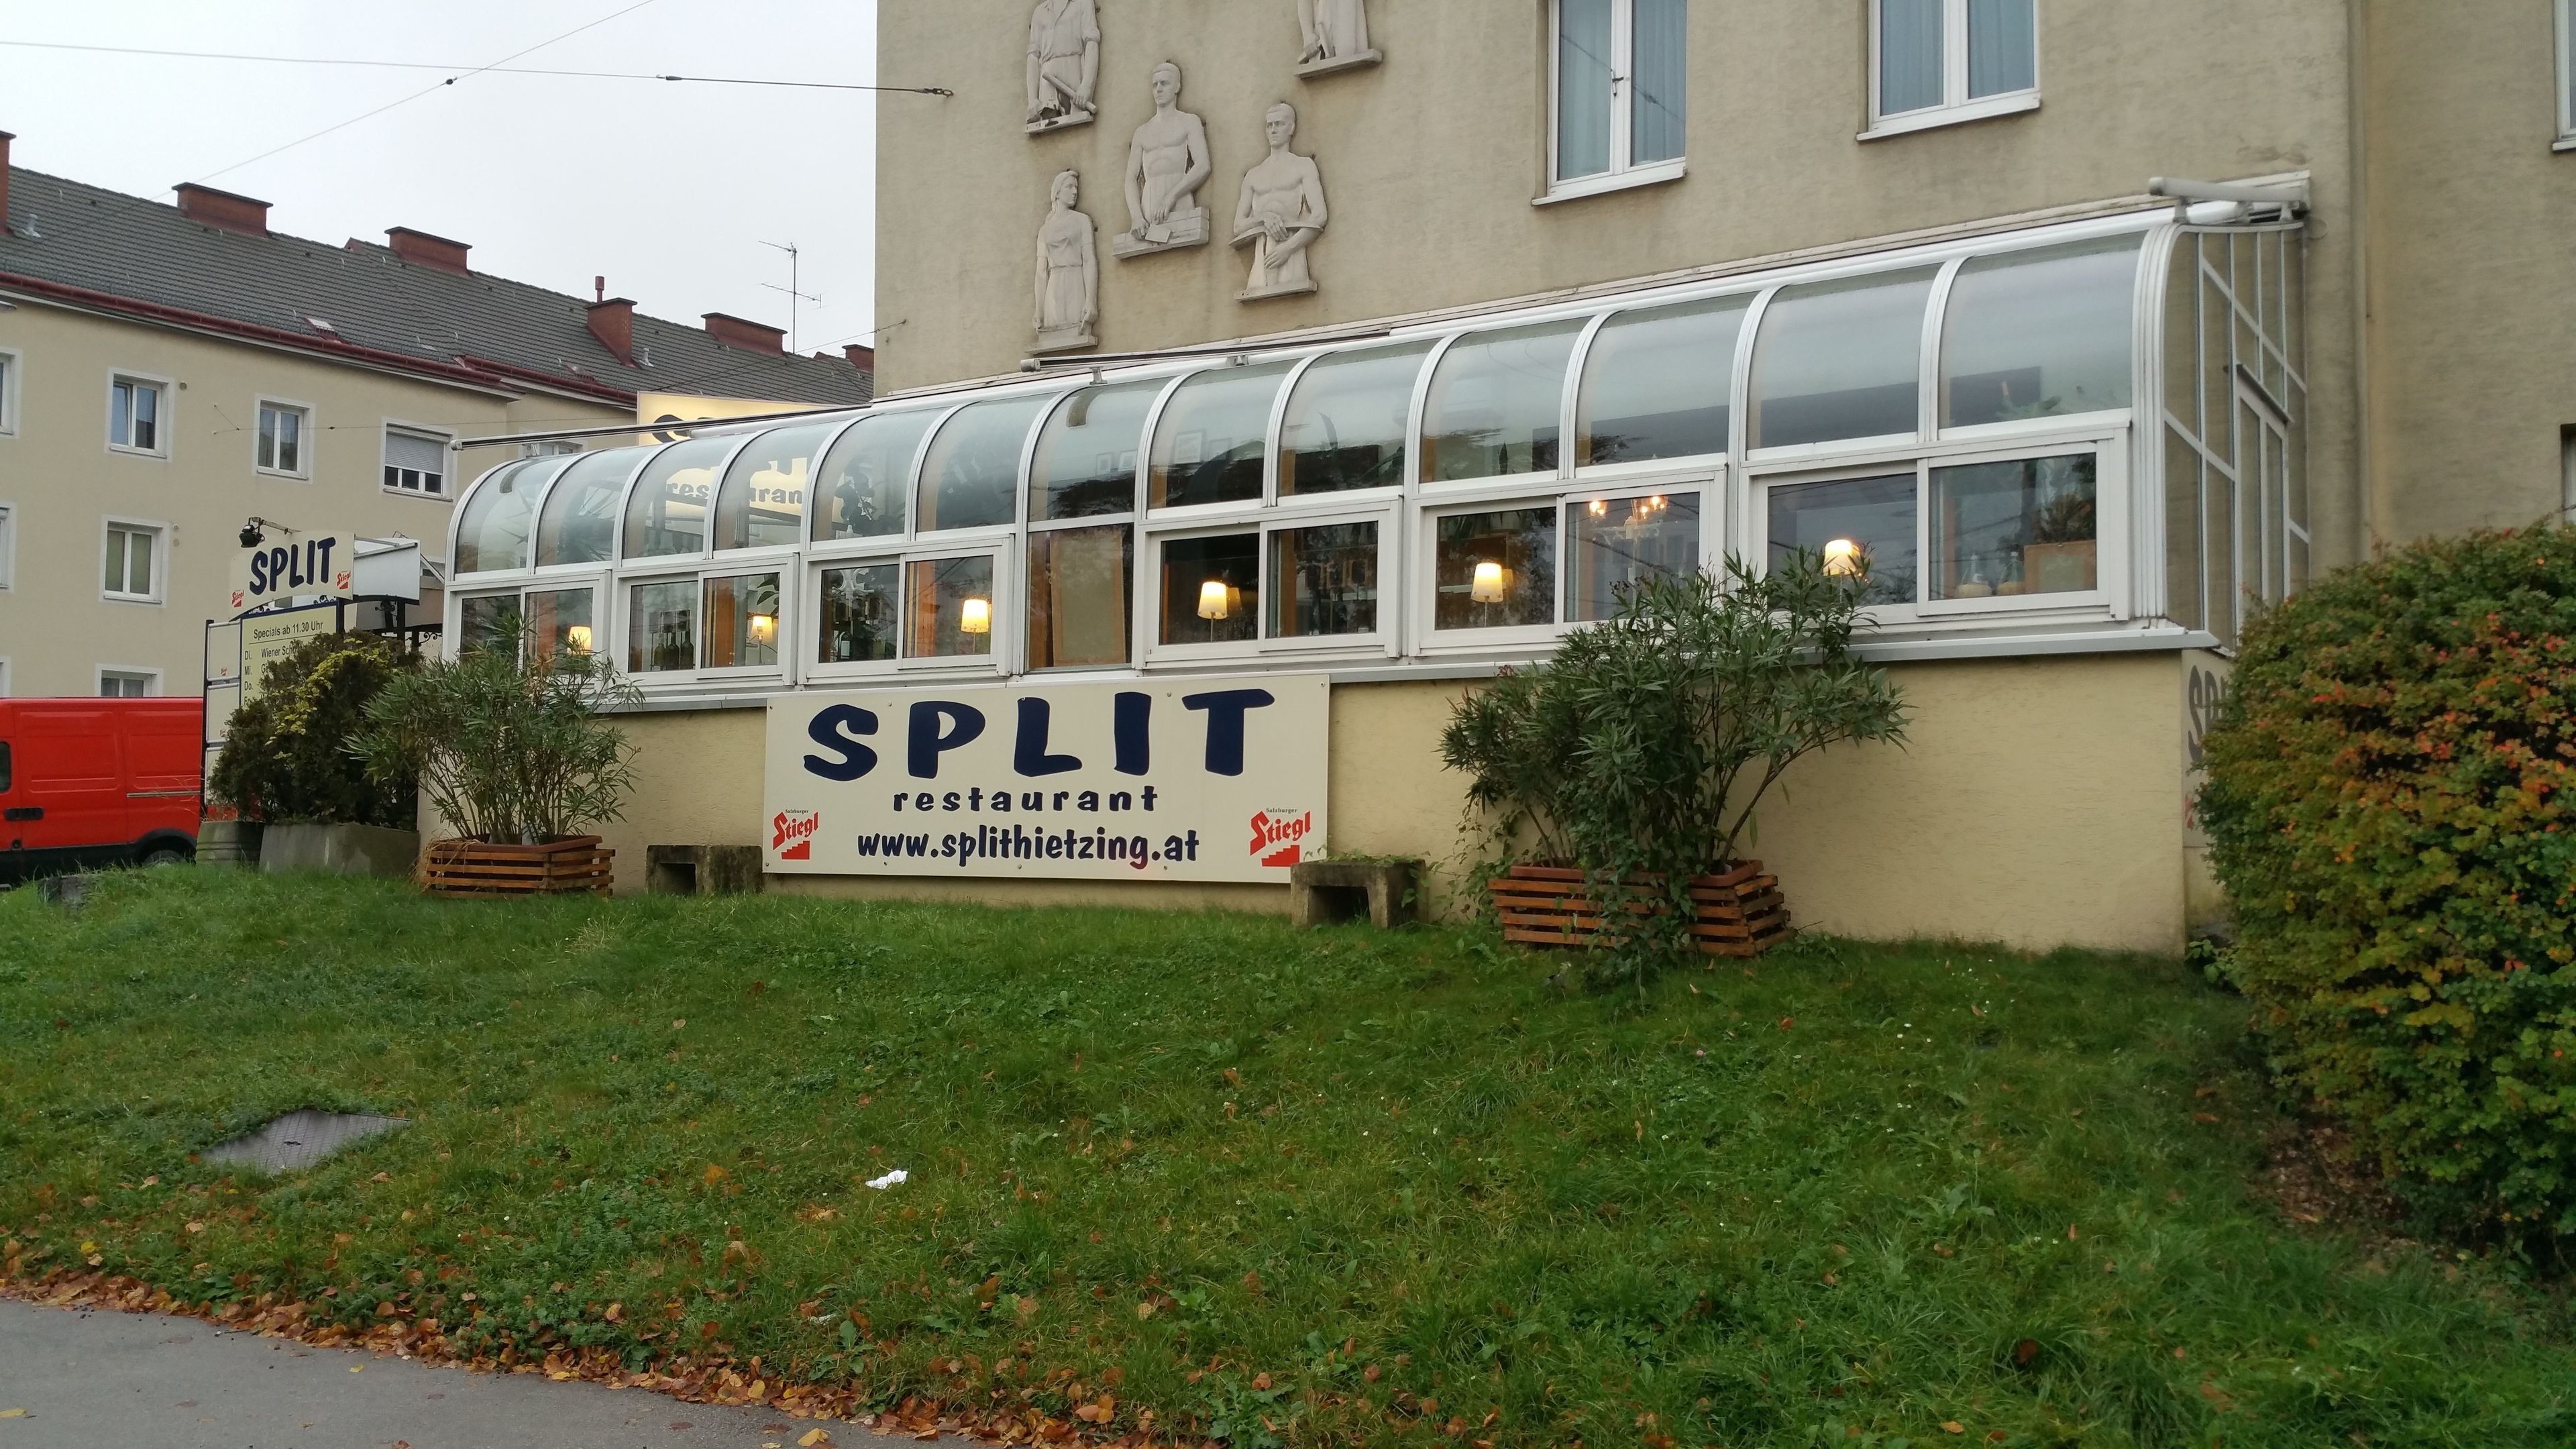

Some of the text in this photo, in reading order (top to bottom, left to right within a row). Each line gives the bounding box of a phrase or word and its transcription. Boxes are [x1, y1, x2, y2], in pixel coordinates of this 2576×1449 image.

[250, 537, 336, 595] SPLIT
[254, 621, 323, 640] Specials ab 11.30 Uhr
[244, 651, 252, 660] Di.
[261, 647, 280, 657] Wiener
[244, 666, 252, 675] Mi.
[244, 681, 253, 691] Do.
[803, 688, 1275, 782] SPLIT
[893, 785, 1158, 812] restaurant
[772, 811, 819, 851] Stiegl
[857, 824, 1199, 870] www.splithietzing.at
[1250, 810, 1311, 857] Stiegl
